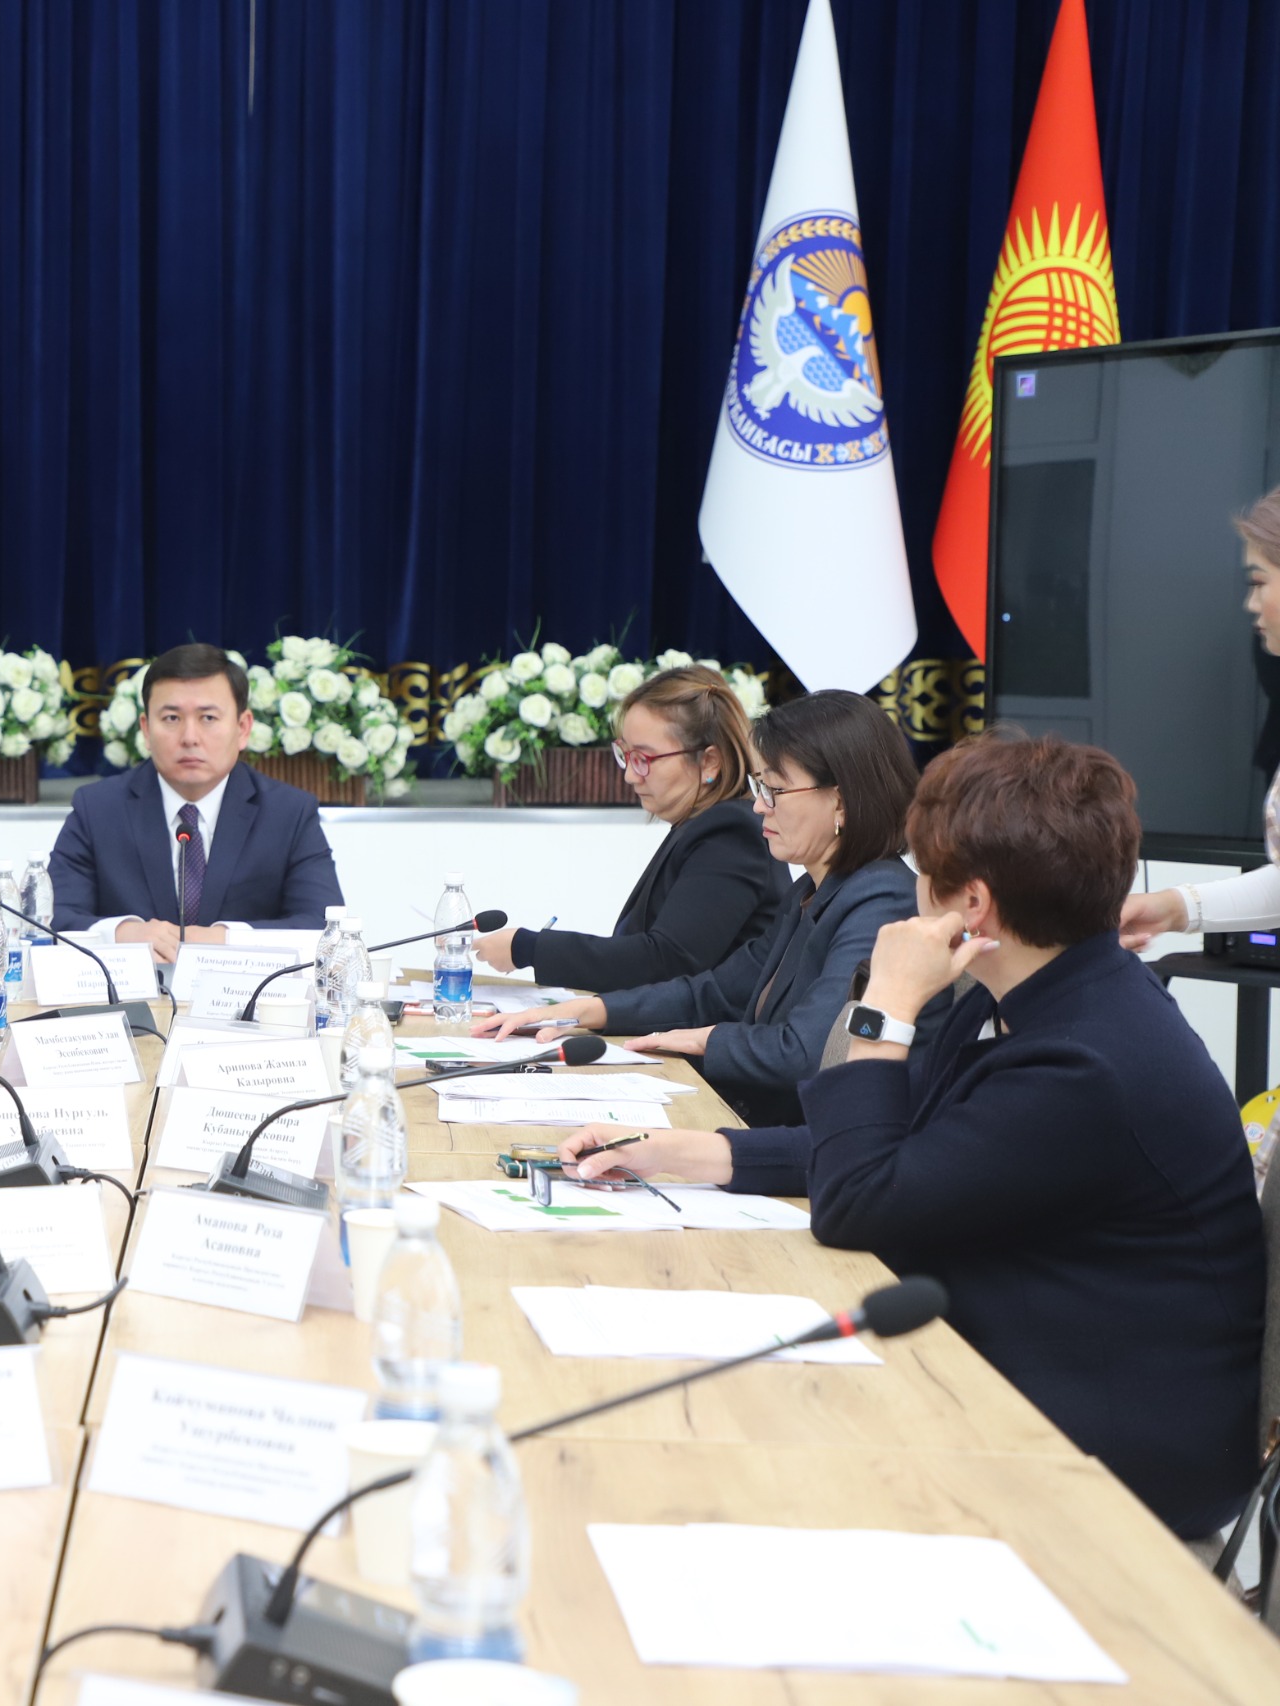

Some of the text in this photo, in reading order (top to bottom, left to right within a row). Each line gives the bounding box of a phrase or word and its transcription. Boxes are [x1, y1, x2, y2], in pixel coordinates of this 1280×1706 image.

[97, 1031, 120, 1040] Улан
[264, 1059, 307, 1070] Жамила
[54, 1108, 108, 1120] Нургуль
[193, 1213, 283, 1239] Аманова Роза
[202, 1238, 261, 1258] Асановна
